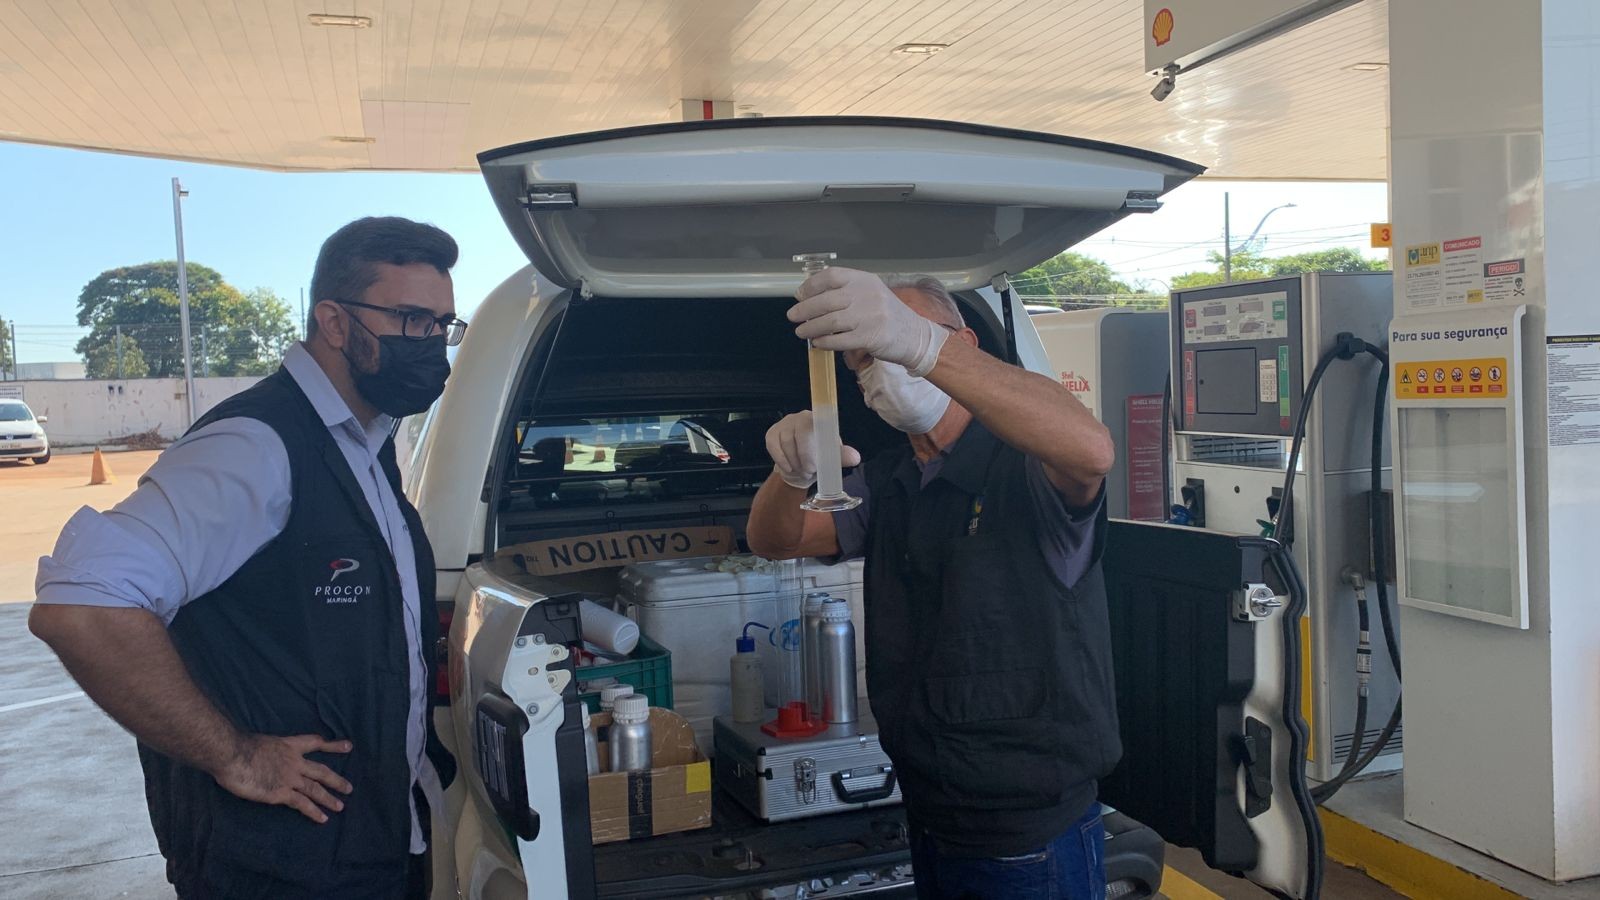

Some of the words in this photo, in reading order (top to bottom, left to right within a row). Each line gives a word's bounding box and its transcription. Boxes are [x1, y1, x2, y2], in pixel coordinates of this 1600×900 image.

[1382, 228, 1390, 241] 3
[1444, 239, 1480, 250] COMUNICADO
[1392, 331, 1417, 342] Para
[1421, 331, 1440, 340] sua
[1444, 326, 1508, 341] segurança
[548, 532, 691, 568] CAUTION
[315, 585, 371, 595] PROCON
[327, 595, 357, 604] MARINGÁ
